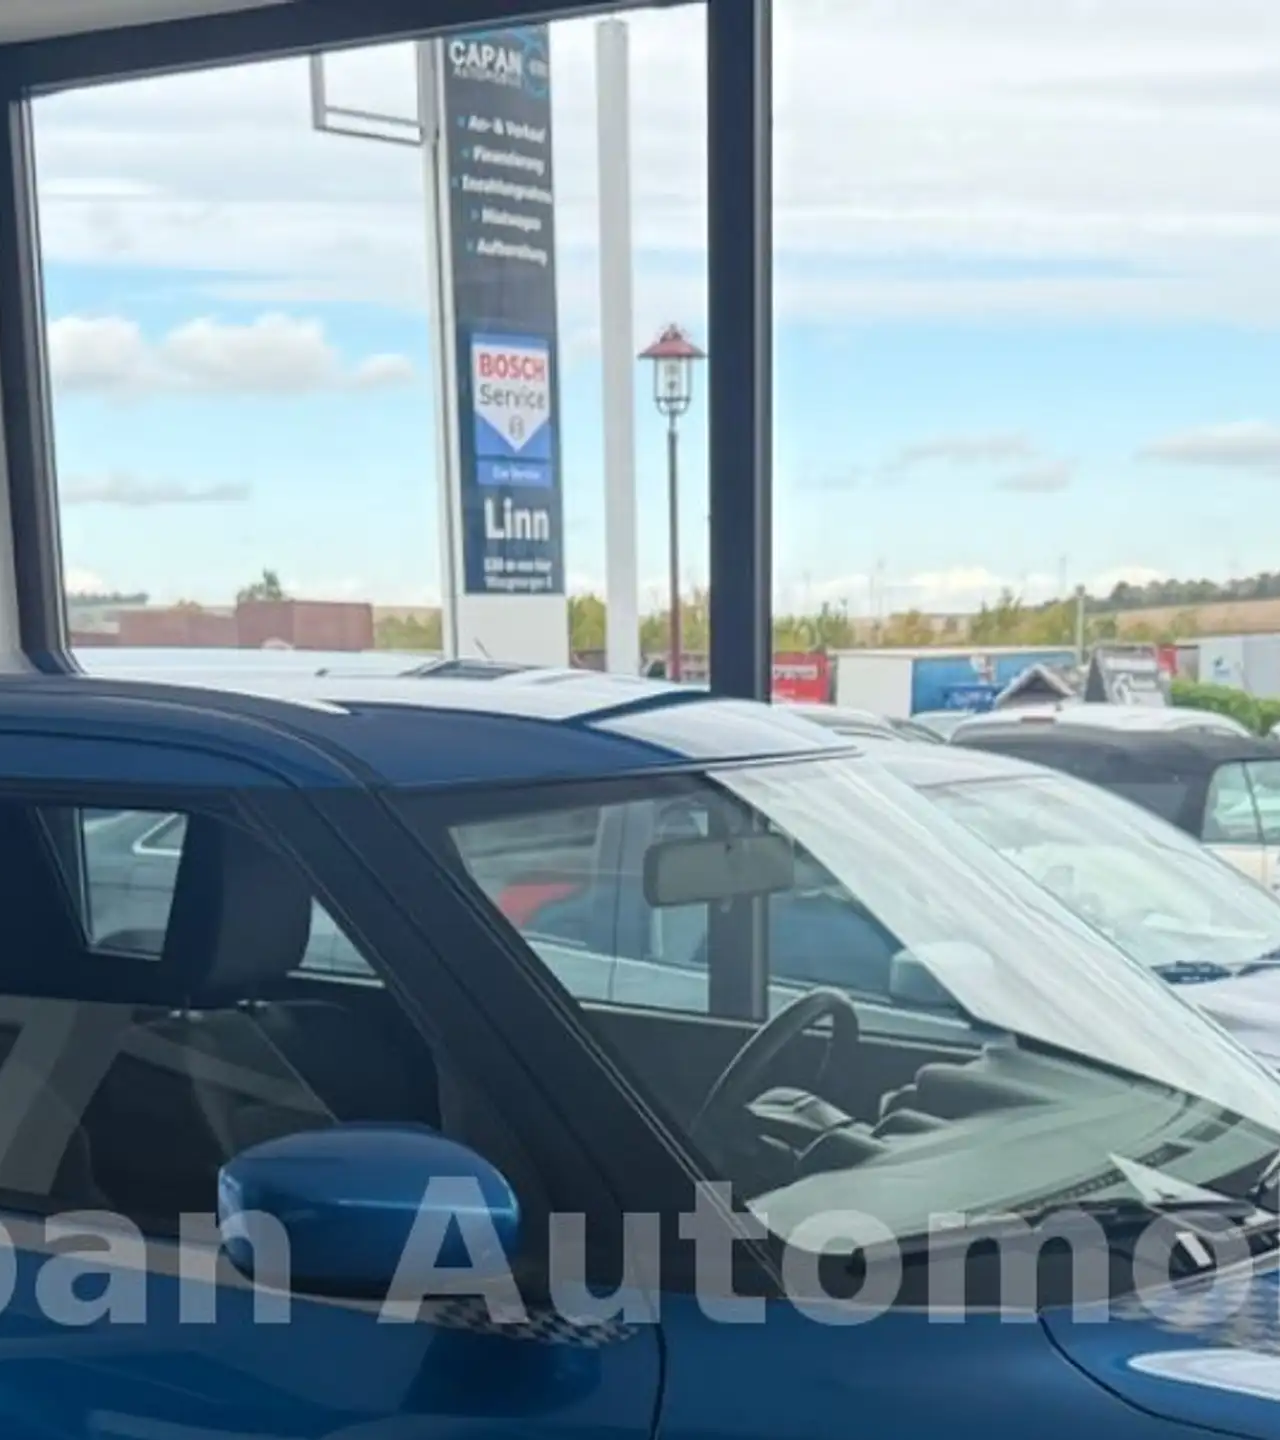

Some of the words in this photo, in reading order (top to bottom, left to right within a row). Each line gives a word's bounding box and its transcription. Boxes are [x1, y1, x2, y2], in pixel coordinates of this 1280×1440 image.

[448, 40, 523, 76] CAPAN
[479, 352, 546, 382] BOSCH
[479, 383, 546, 411] Service
[484, 497, 550, 541] Linn
